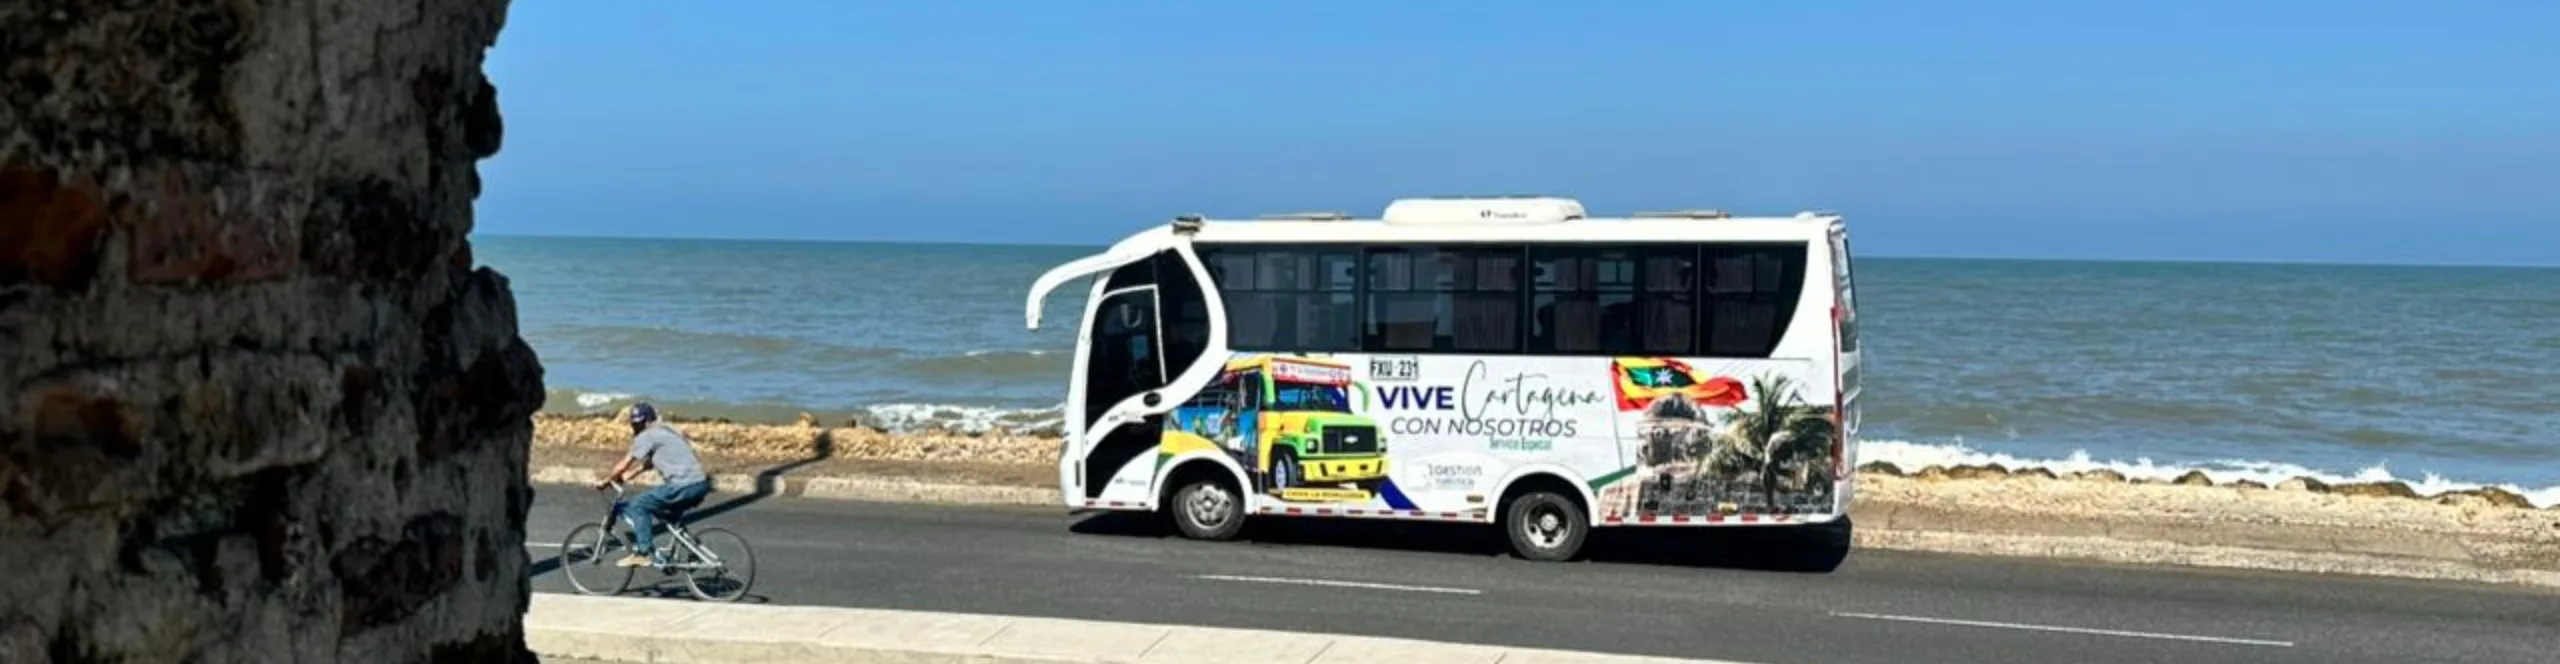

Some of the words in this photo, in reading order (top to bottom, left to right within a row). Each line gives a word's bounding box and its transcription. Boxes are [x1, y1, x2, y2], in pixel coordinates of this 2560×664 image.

[1377, 386, 1454, 410] VIVE
[1461, 359, 1605, 423] Cartagena
[1391, 418, 1442, 436] CON
[1449, 418, 1579, 438] NOSOTROS
